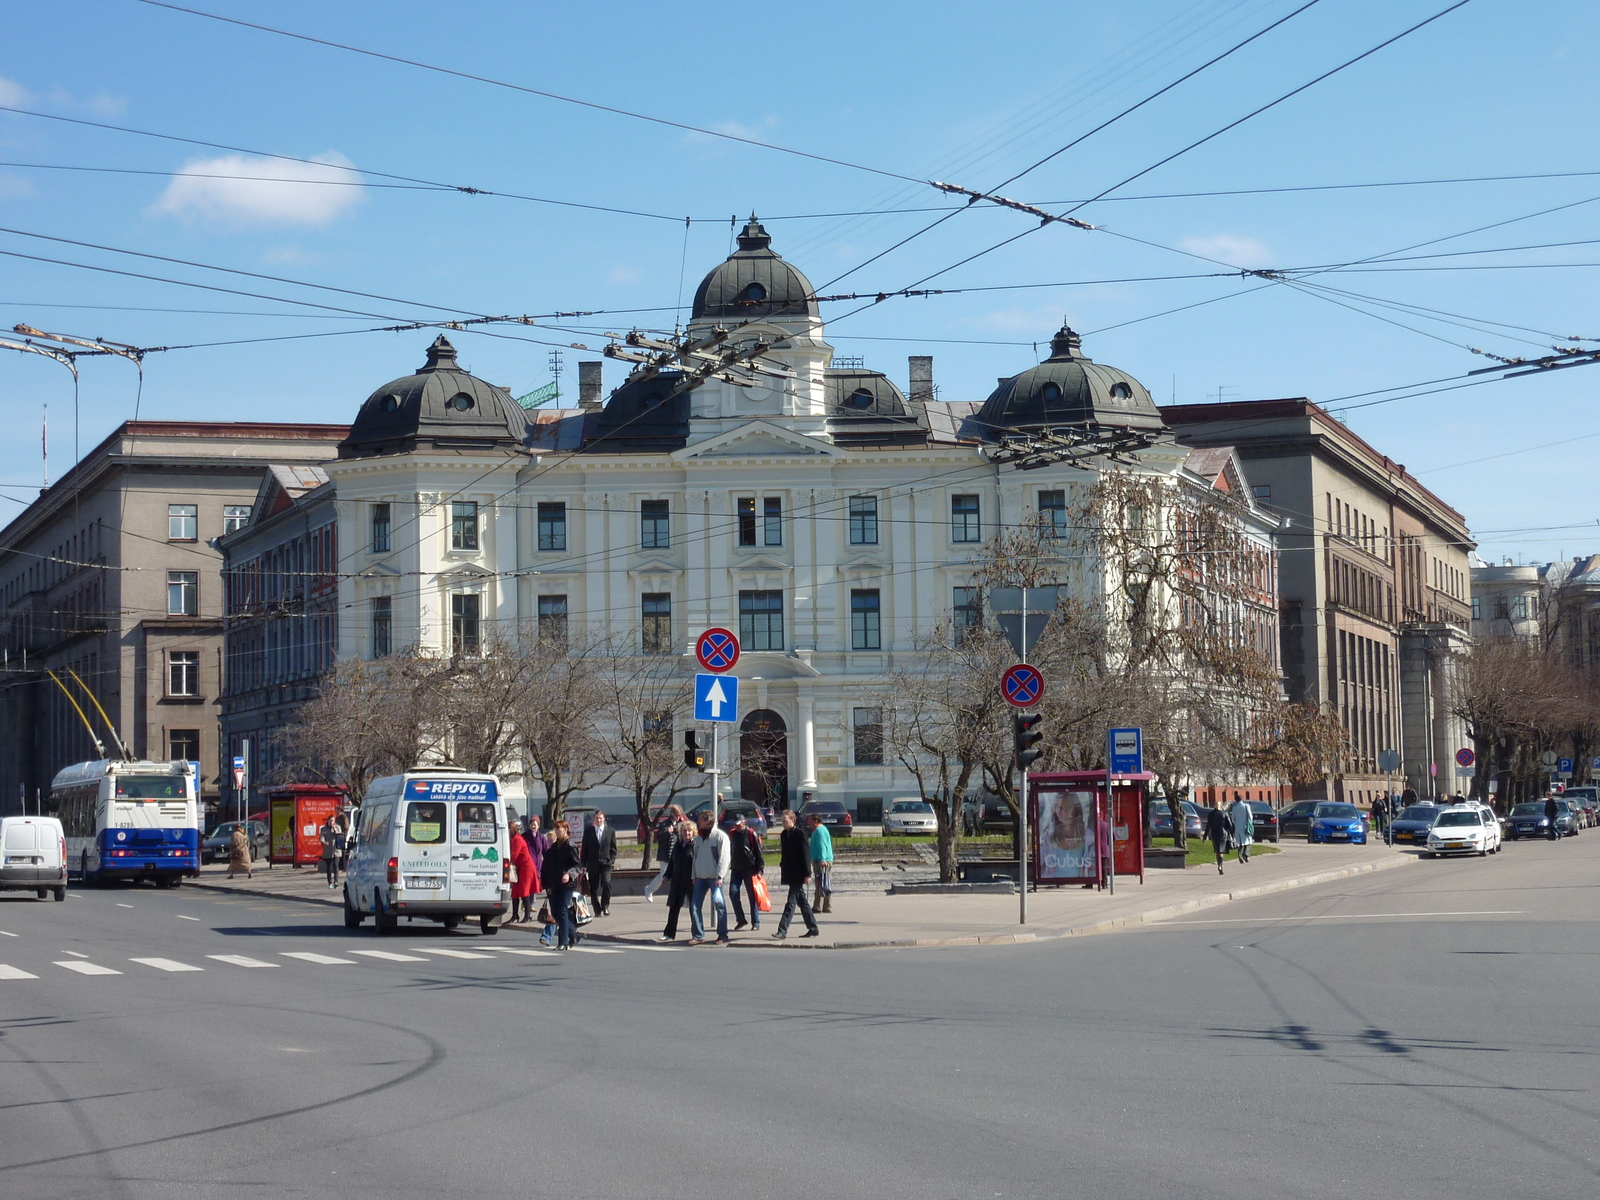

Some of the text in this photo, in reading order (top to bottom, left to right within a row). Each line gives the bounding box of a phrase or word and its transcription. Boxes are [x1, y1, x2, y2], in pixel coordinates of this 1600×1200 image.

[1561, 760, 1569, 770] P
[165, 786, 172, 795] 4
[431, 783, 487, 794] REPSOL
[1044, 853, 1092, 868] Cubus
